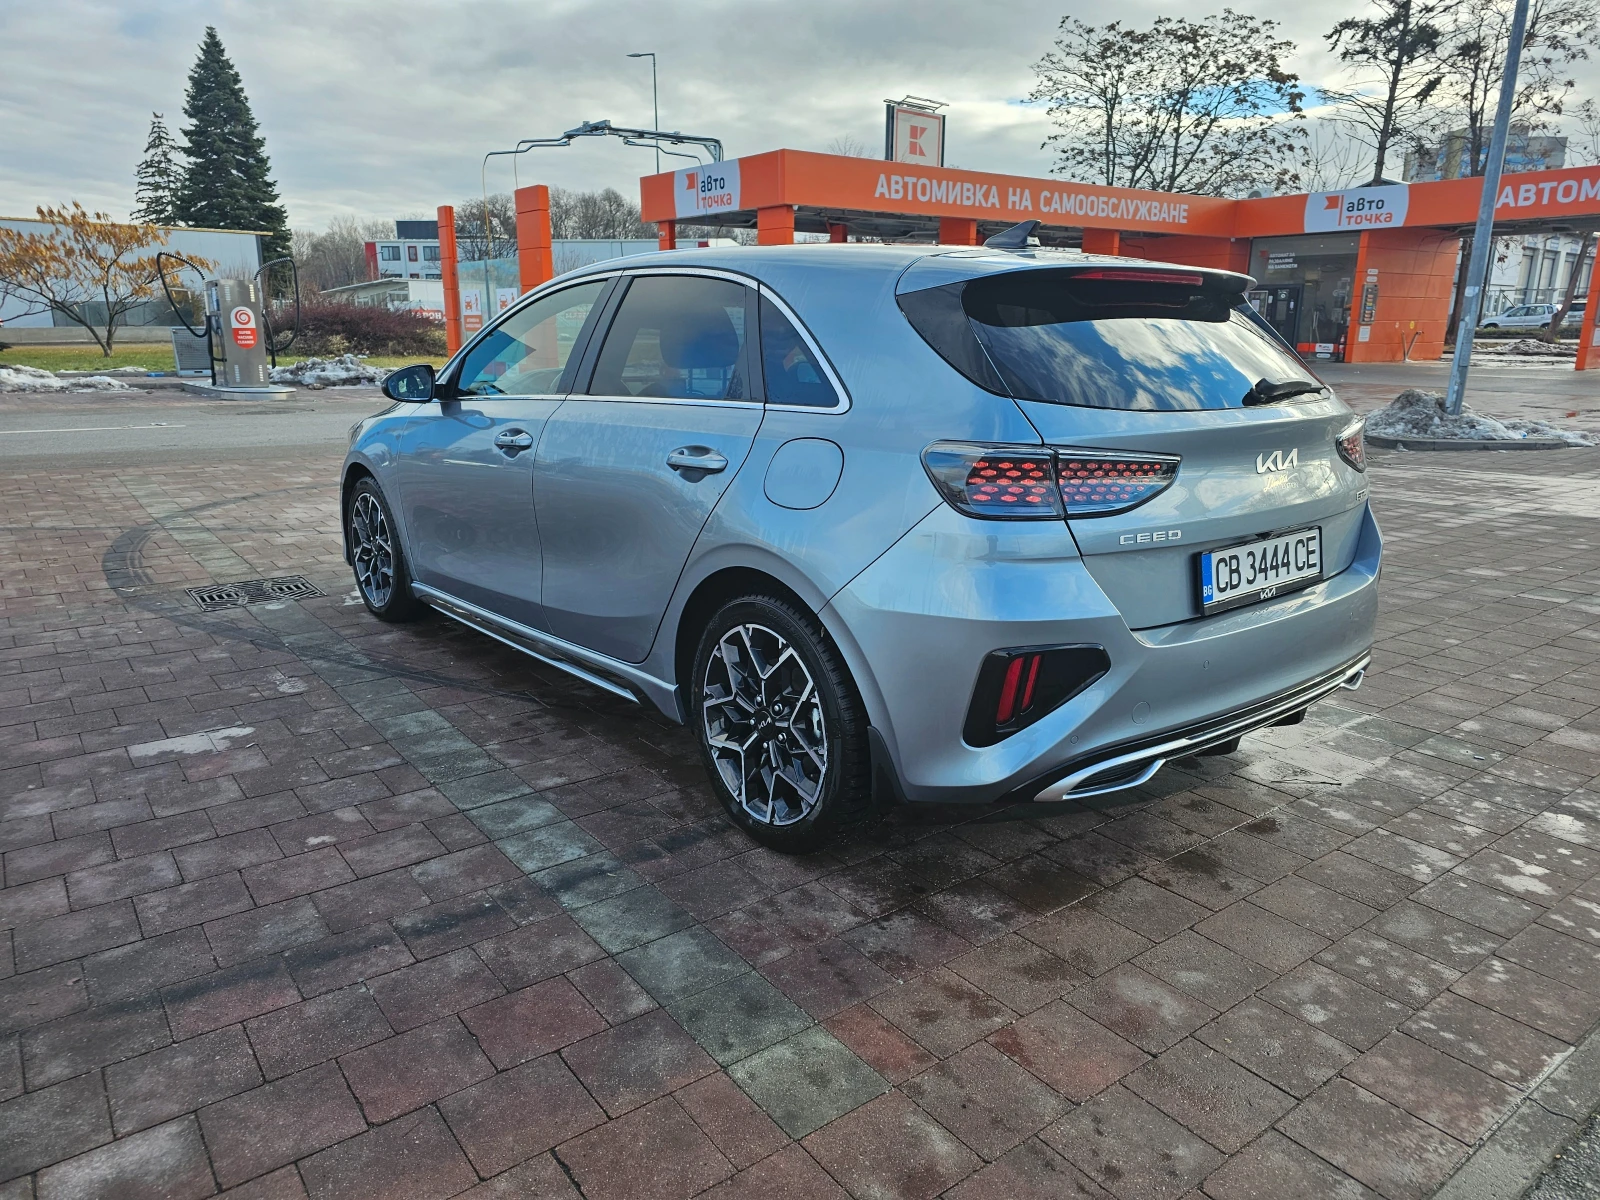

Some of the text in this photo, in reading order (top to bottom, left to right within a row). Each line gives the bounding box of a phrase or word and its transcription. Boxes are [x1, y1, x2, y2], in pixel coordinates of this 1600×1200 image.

[700, 175, 725, 193] авто
[701, 192, 732, 209] точка
[874, 174, 1189, 224] АВТОМИВКА НА САМООБСЛУЖВАНЕ
[1346, 197, 1385, 212] авто
[1345, 212, 1393, 226] точка
[1256, 448, 1298, 474] KIA
[1119, 530, 1182, 545] CEED
[1215, 535, 1318, 594] CB 3444 CE
[1203, 584, 1213, 597] BG
[1260, 586, 1276, 600] KIA
